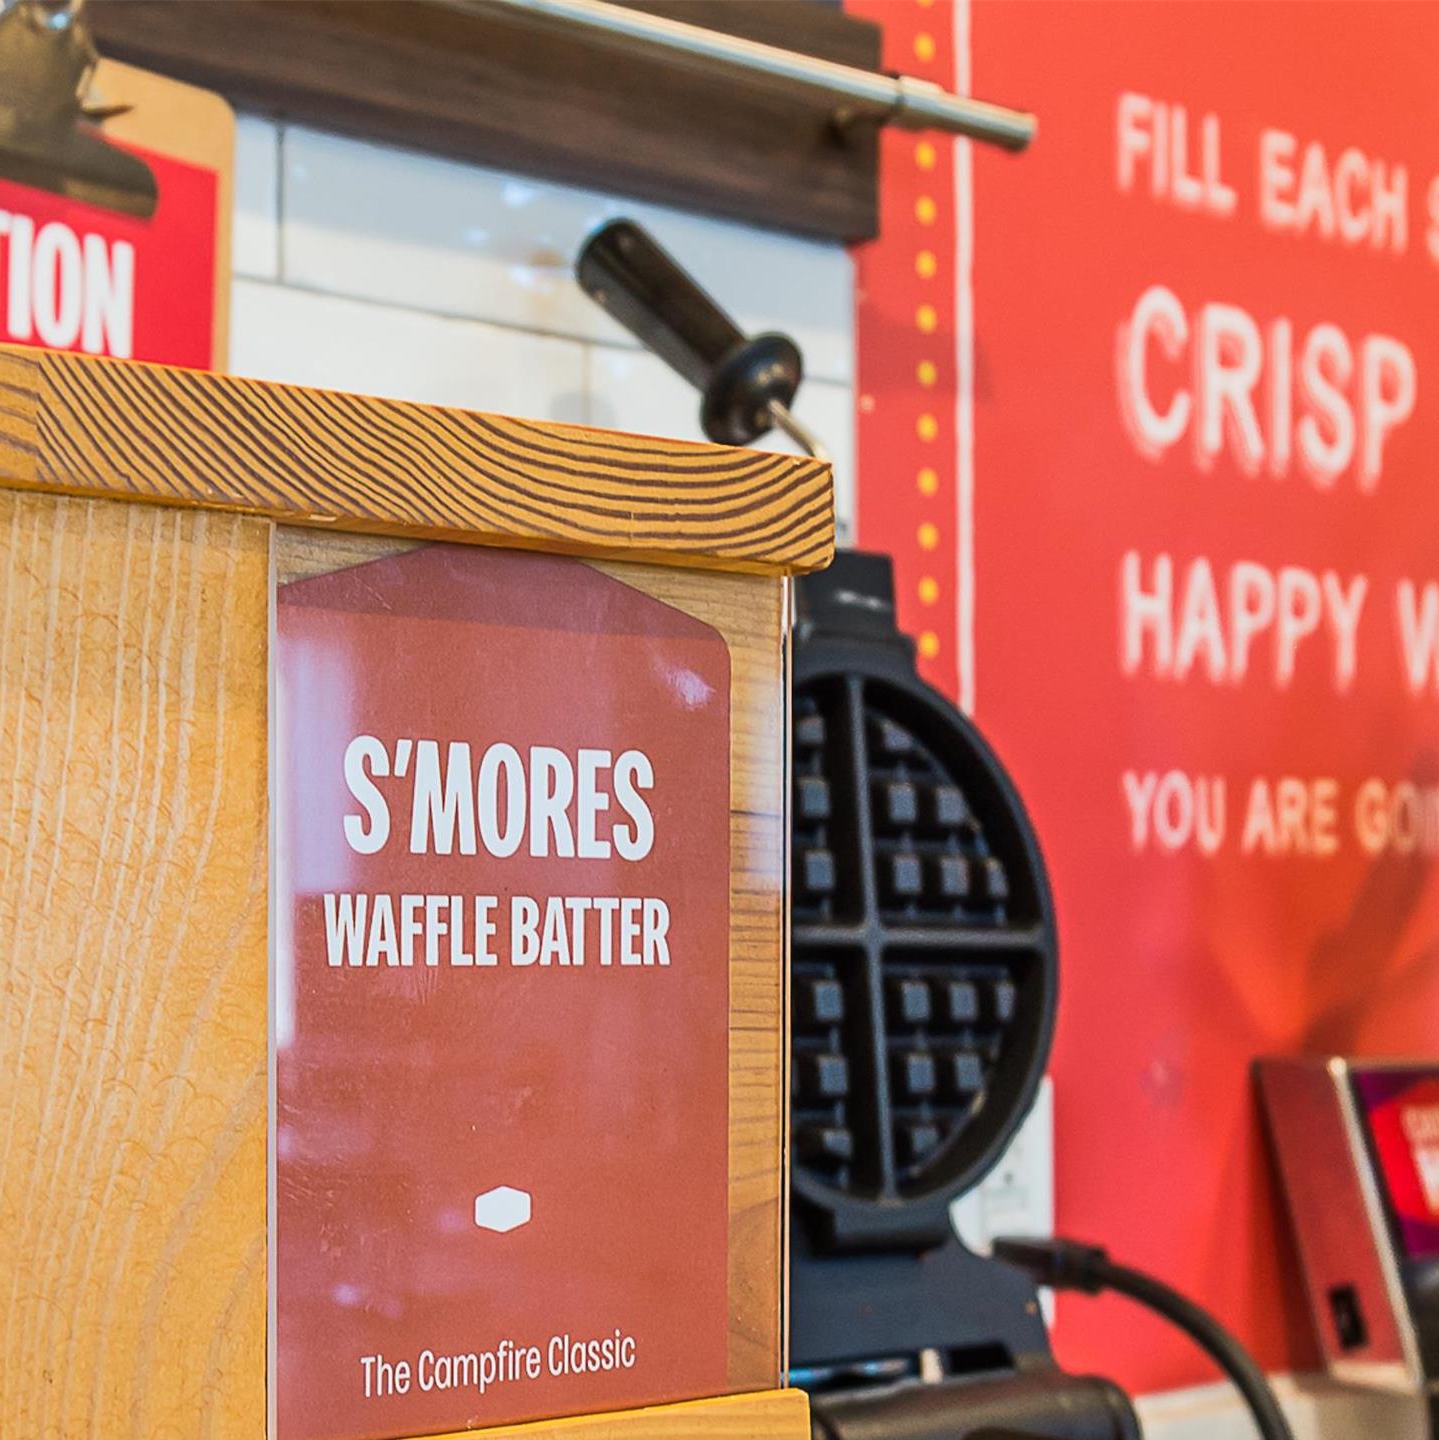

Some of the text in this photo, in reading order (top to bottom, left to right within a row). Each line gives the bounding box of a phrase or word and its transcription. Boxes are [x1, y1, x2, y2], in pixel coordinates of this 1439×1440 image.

[1117, 93, 1237, 215] FILL
[1260, 129, 1407, 250] EACH
[1118, 286, 1416, 489] CRISP
[1122, 551, 1367, 685] HAPPY
[343, 735, 654, 861] S'MORES
[1123, 770, 1225, 854] YOU
[1242, 778, 1337, 857] ARE
[323, 893, 670, 966] WAFFLE BATTER
[361, 1329, 635, 1397] The Campfire Classic
